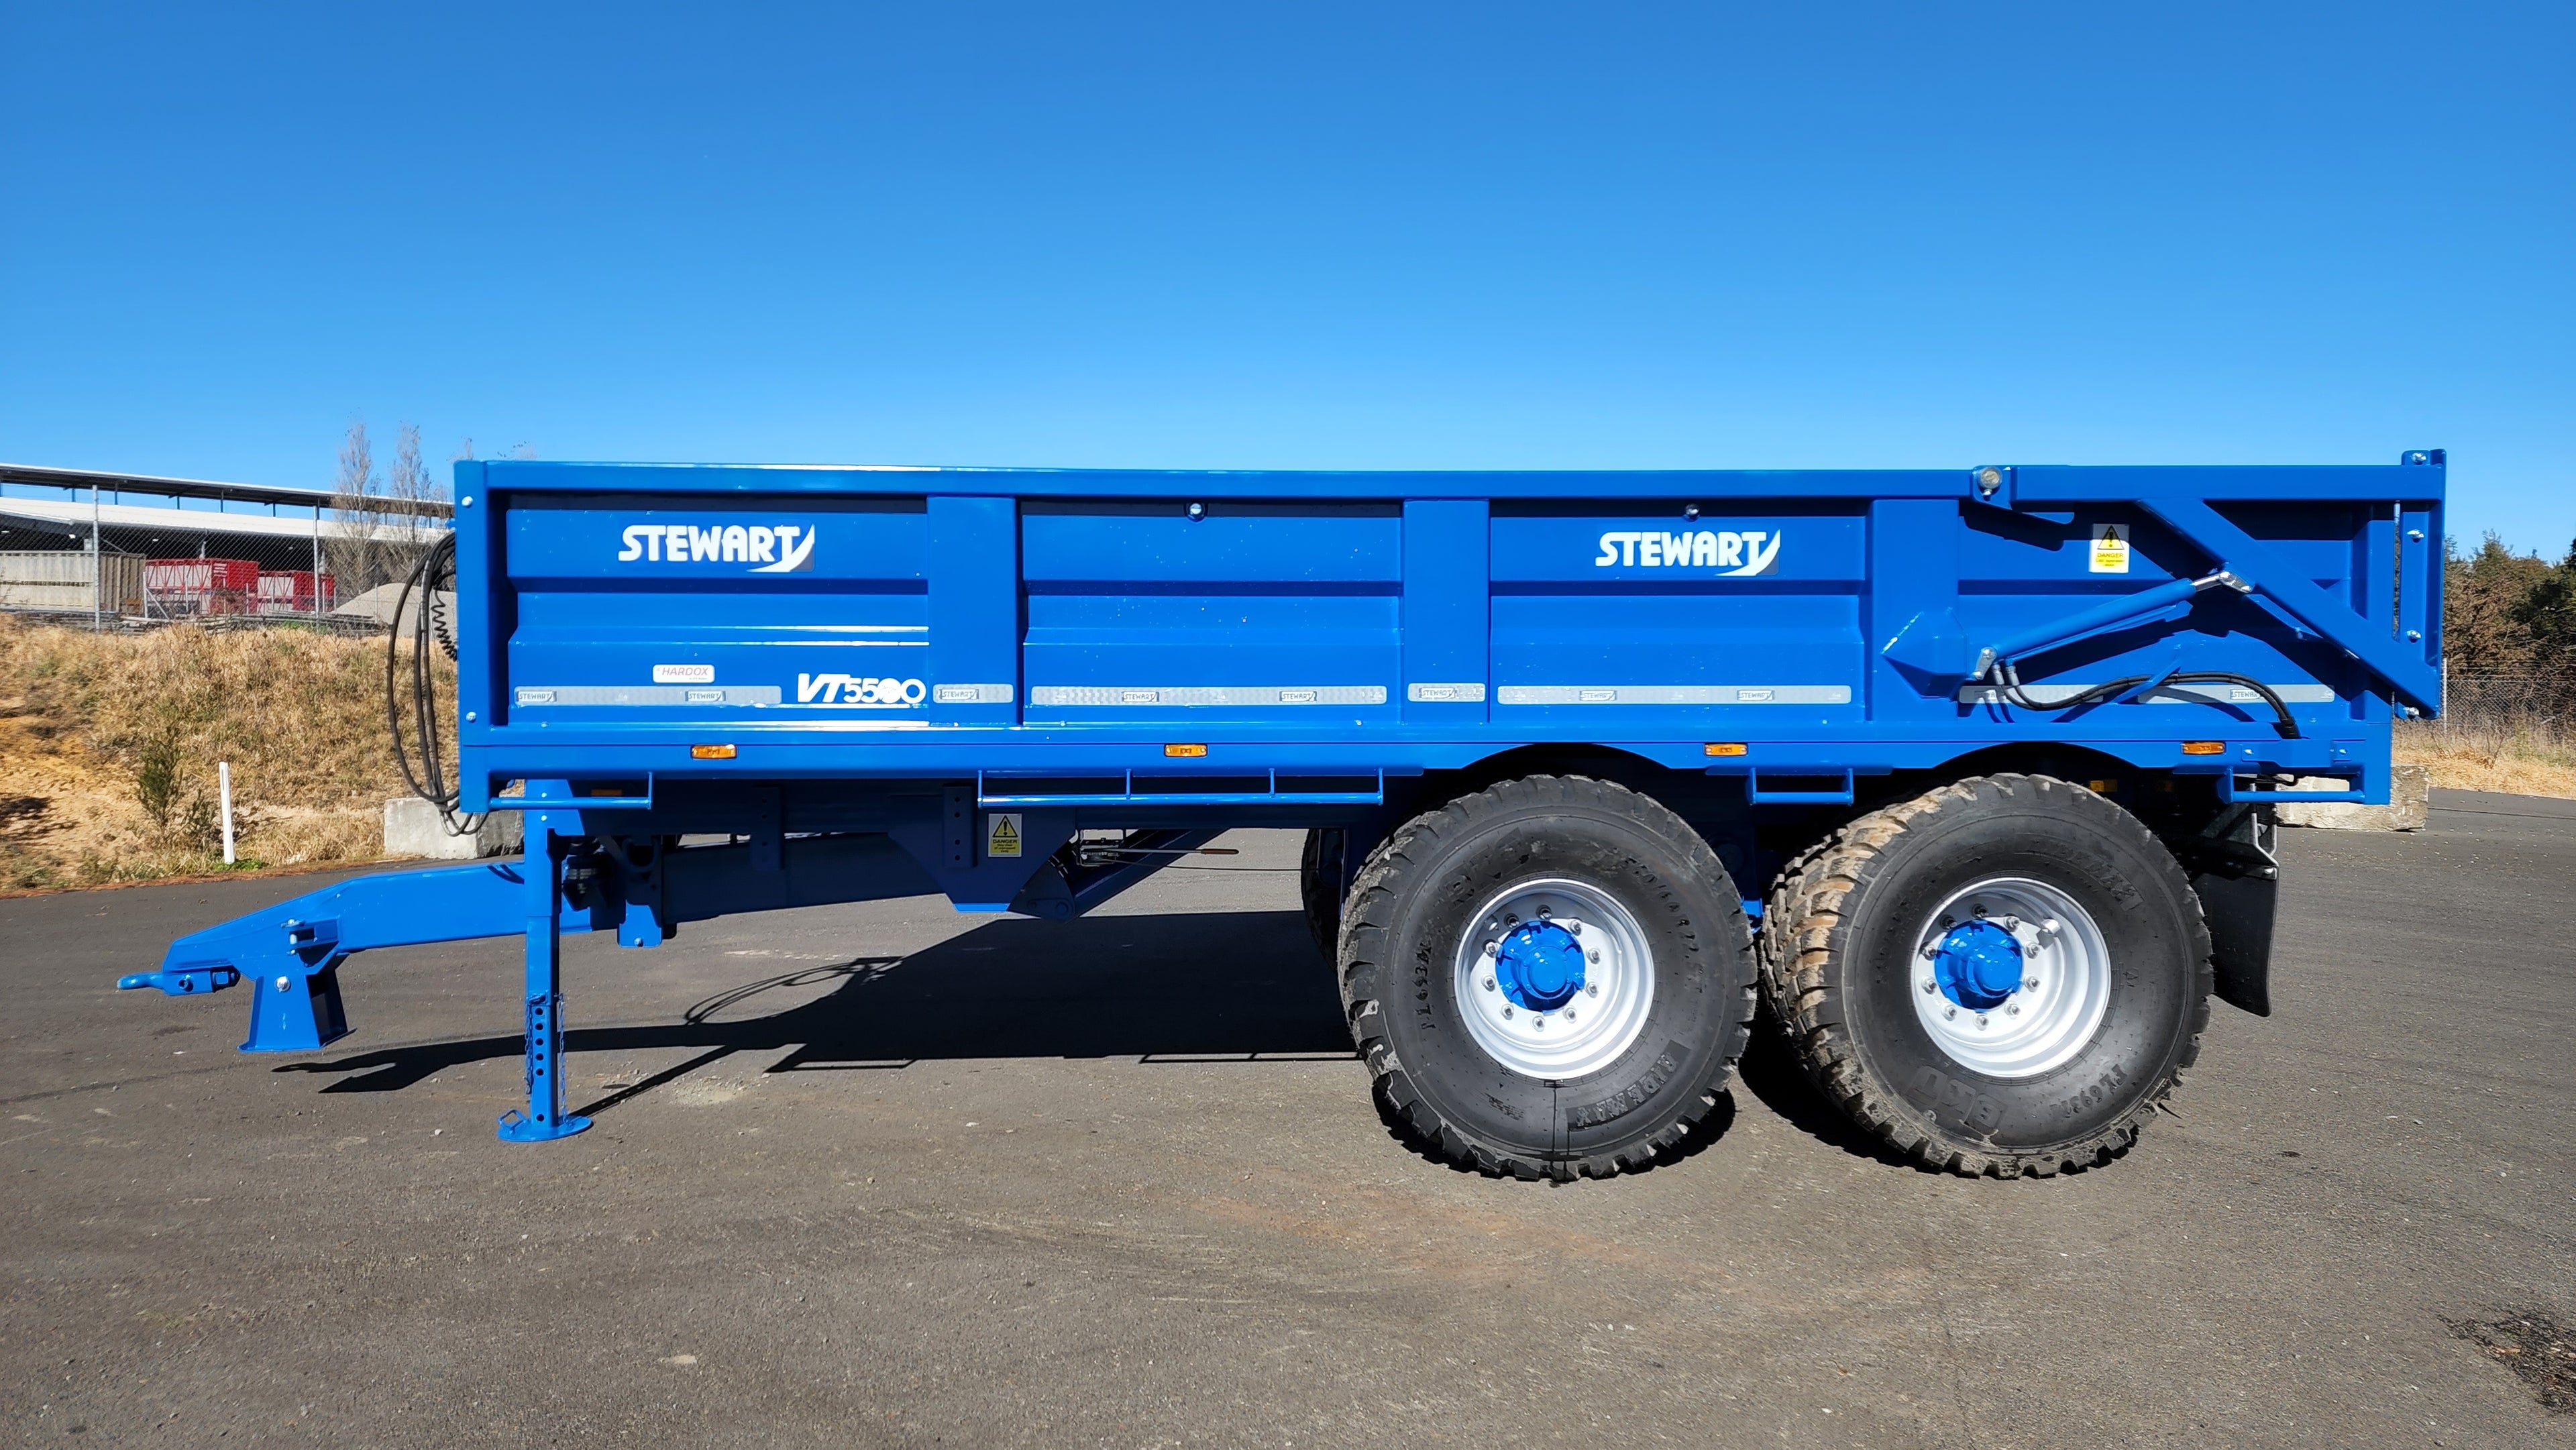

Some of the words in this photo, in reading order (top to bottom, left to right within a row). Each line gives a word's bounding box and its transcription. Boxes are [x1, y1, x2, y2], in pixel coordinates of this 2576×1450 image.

[618, 524, 815, 573] STEWART
[1595, 528, 1781, 577] STEWART
[661, 667, 708, 676] HARDOX
[798, 673, 926, 704] VT5500
[519, 691, 553, 702] STEWART
[688, 691, 722, 702] STEWART
[942, 689, 976, 700] STEWART
[1124, 692, 1157, 702] STEWART
[1281, 691, 1315, 702] STEWART
[1580, 691, 1615, 701] STEWART
[1739, 691, 1774, 701] STEWART
